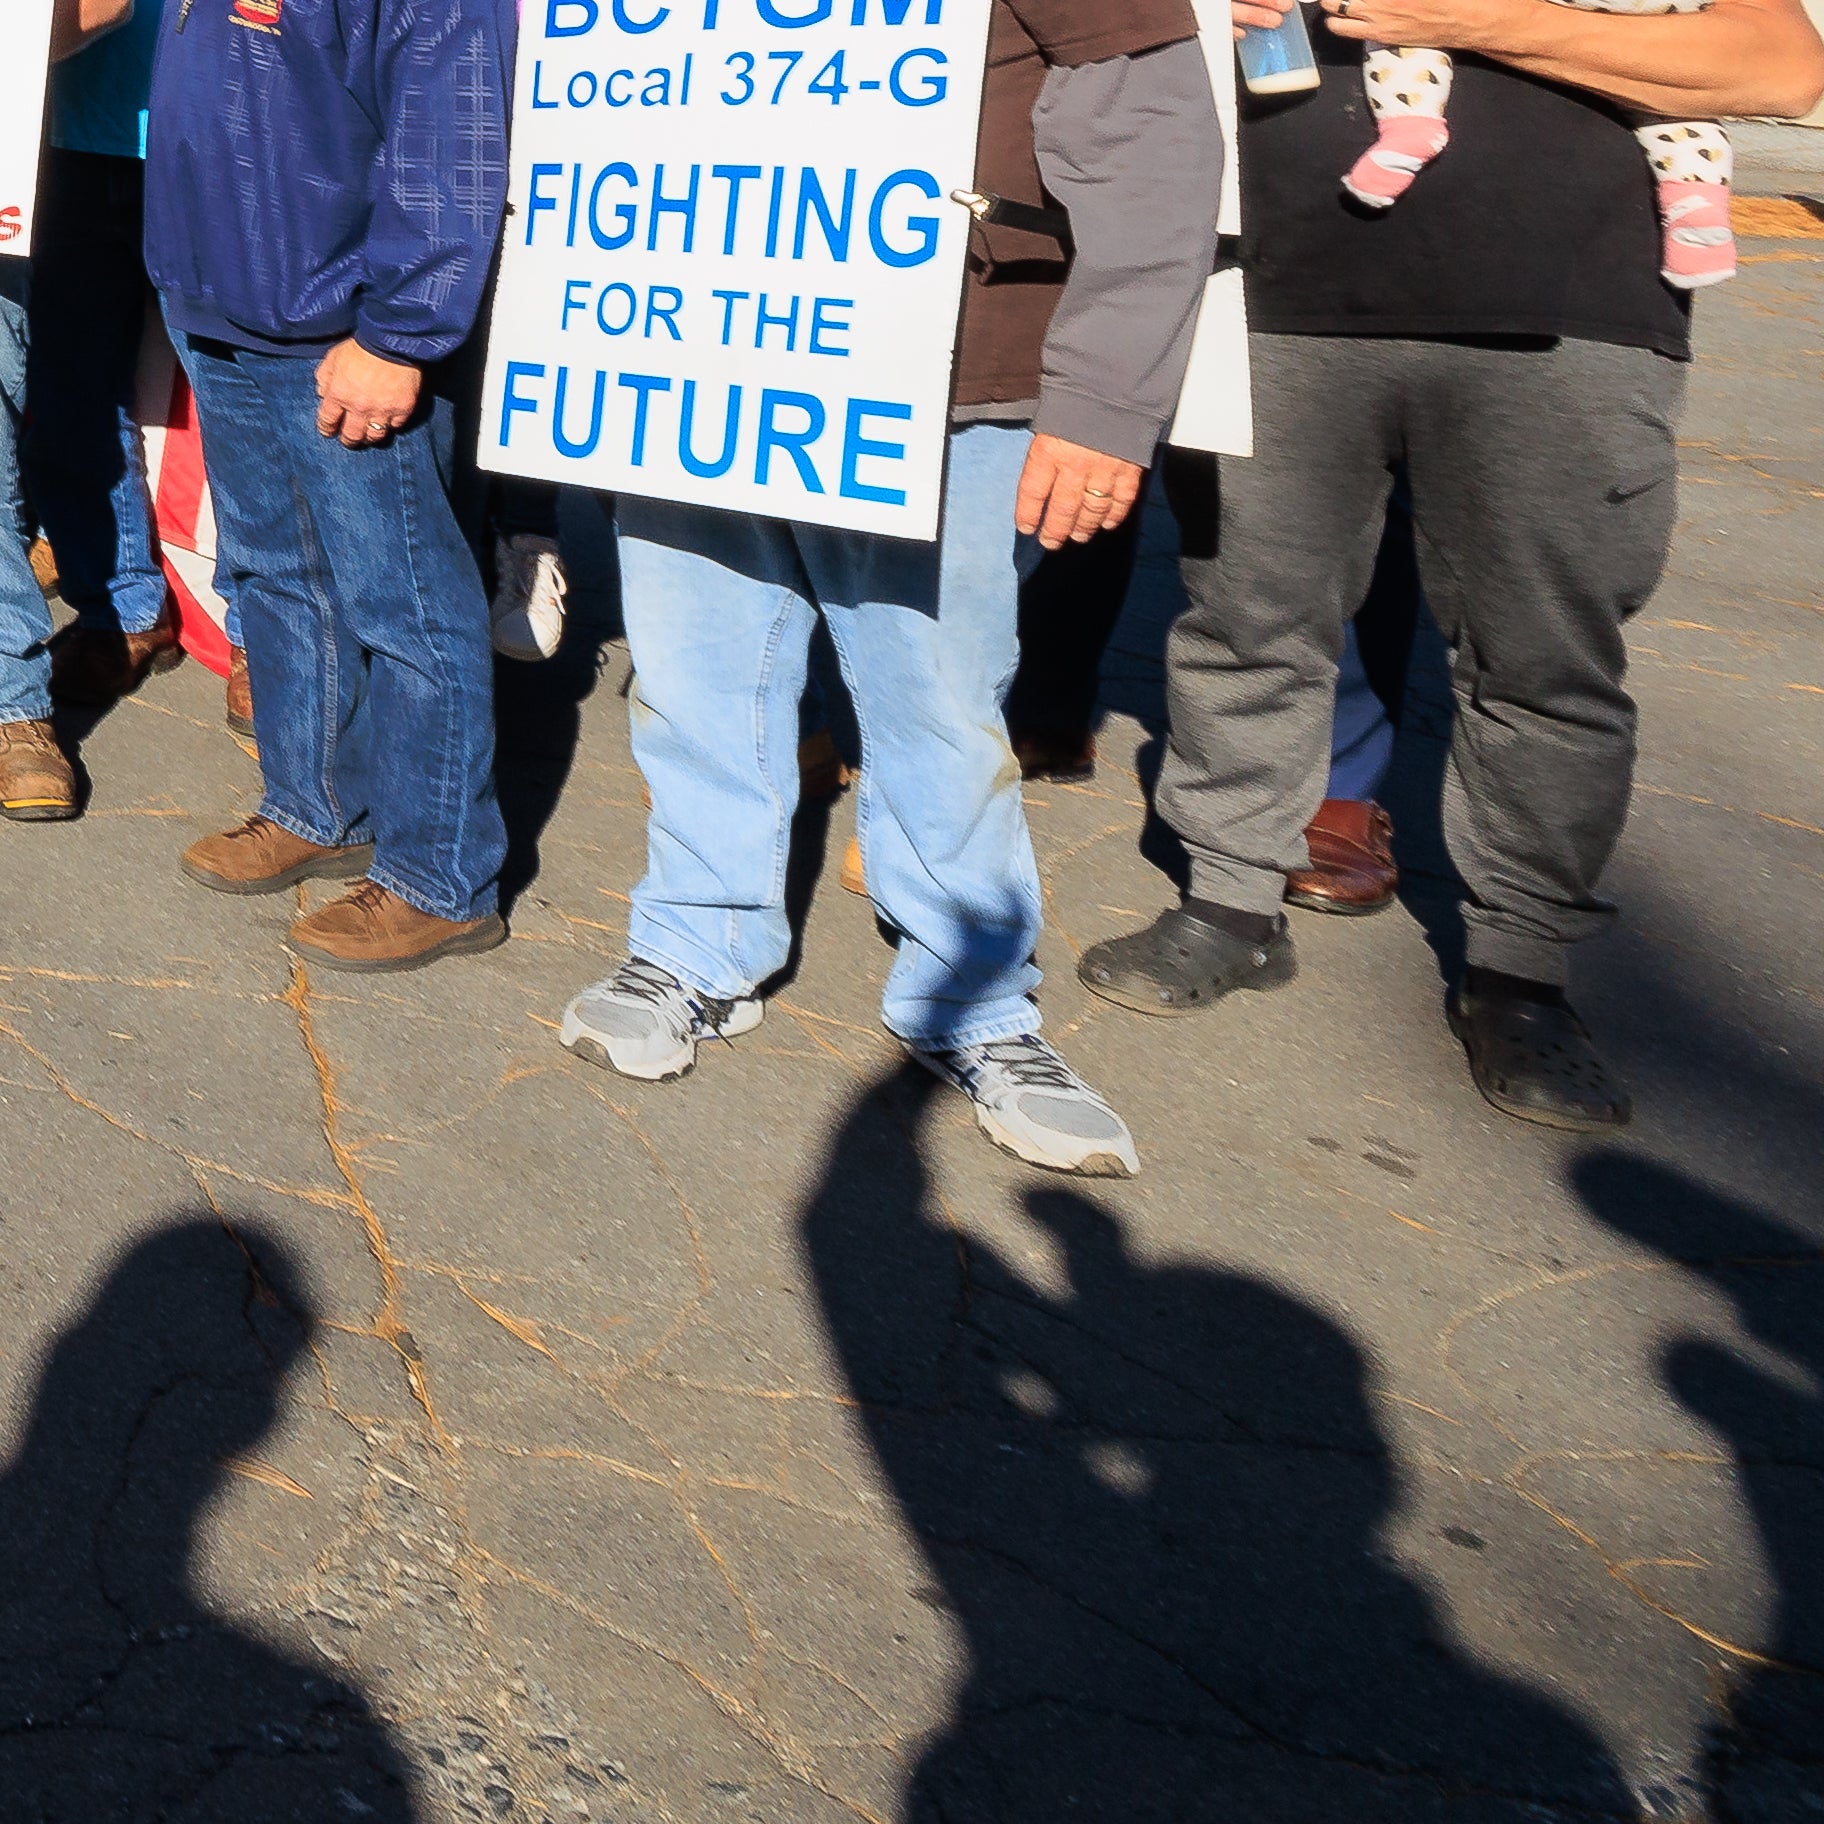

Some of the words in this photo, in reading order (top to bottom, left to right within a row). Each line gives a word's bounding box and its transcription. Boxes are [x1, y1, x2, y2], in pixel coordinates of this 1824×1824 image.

[532, 53, 692, 111] Local
[720, 47, 949, 109] 374-G
[525, 161, 942, 269] FIGHTING
[561, 279, 684, 342] FOR
[711, 288, 855, 359] THE
[499, 360, 914, 507] FUTURE
